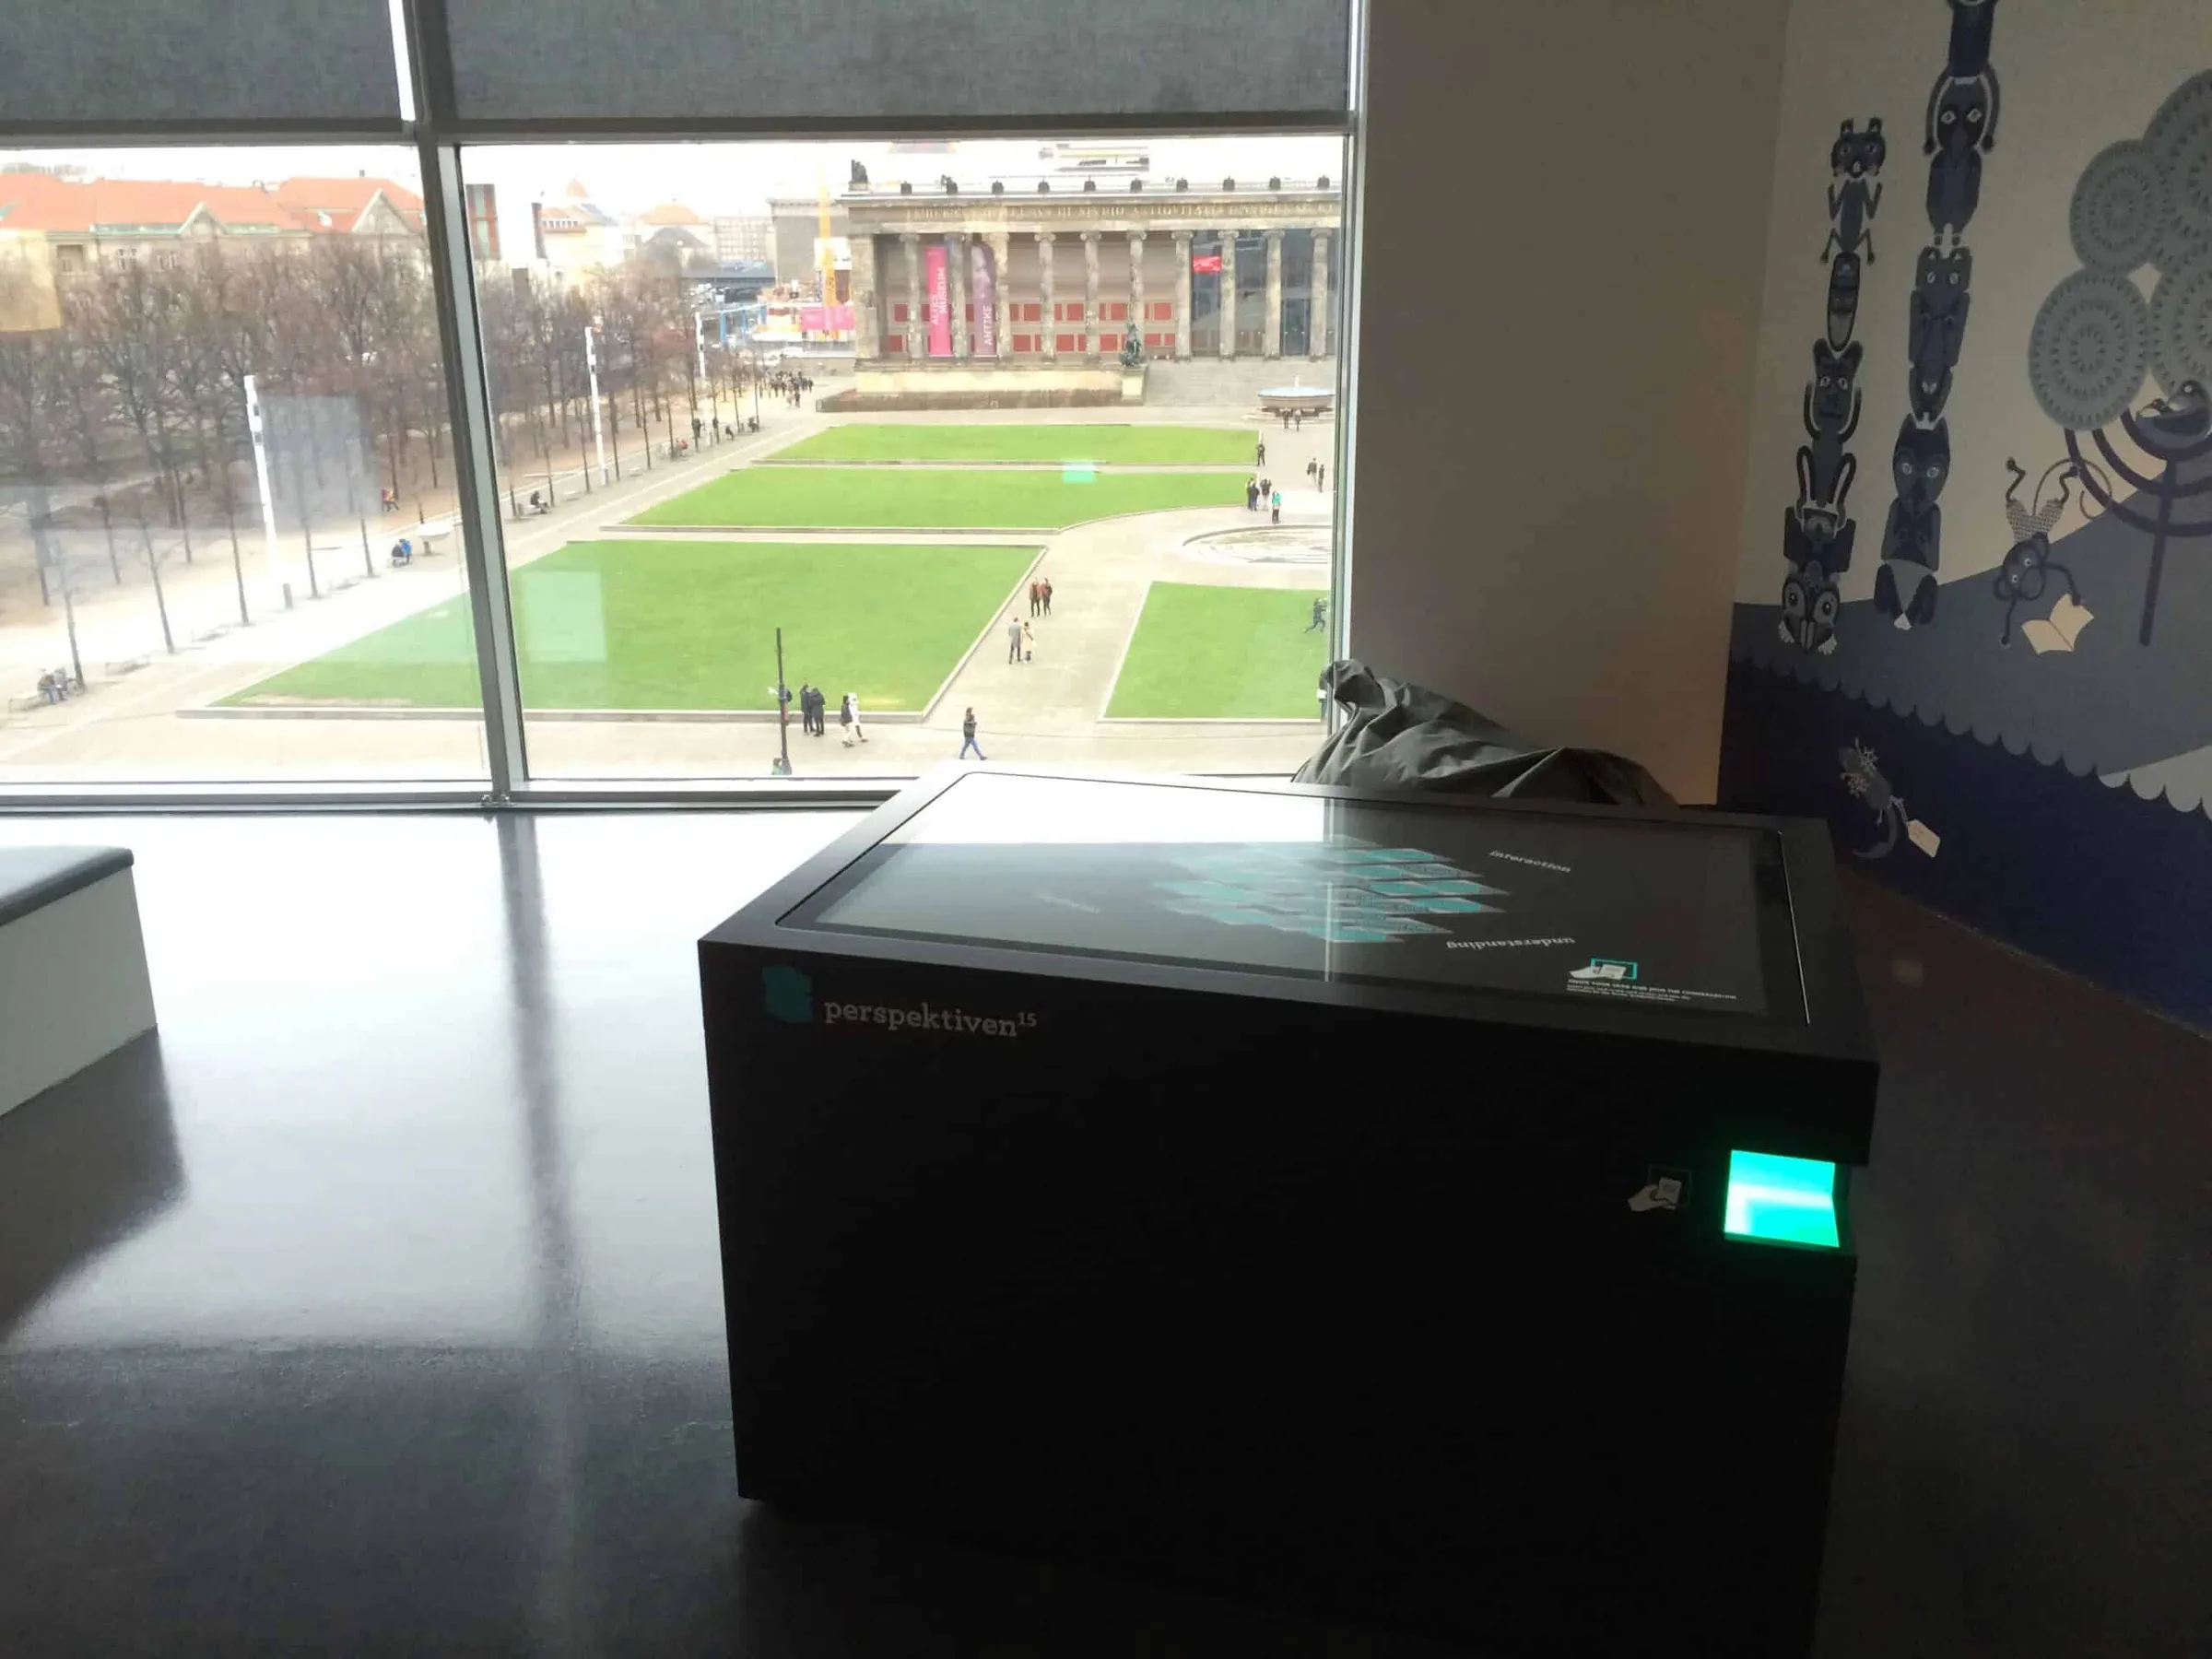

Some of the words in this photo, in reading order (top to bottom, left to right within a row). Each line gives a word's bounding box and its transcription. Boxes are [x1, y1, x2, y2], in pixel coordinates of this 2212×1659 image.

[936, 266, 947, 313] MUSEUM
[982, 304, 994, 346] ANTIKE
[1445, 935, 1576, 950] understanding
